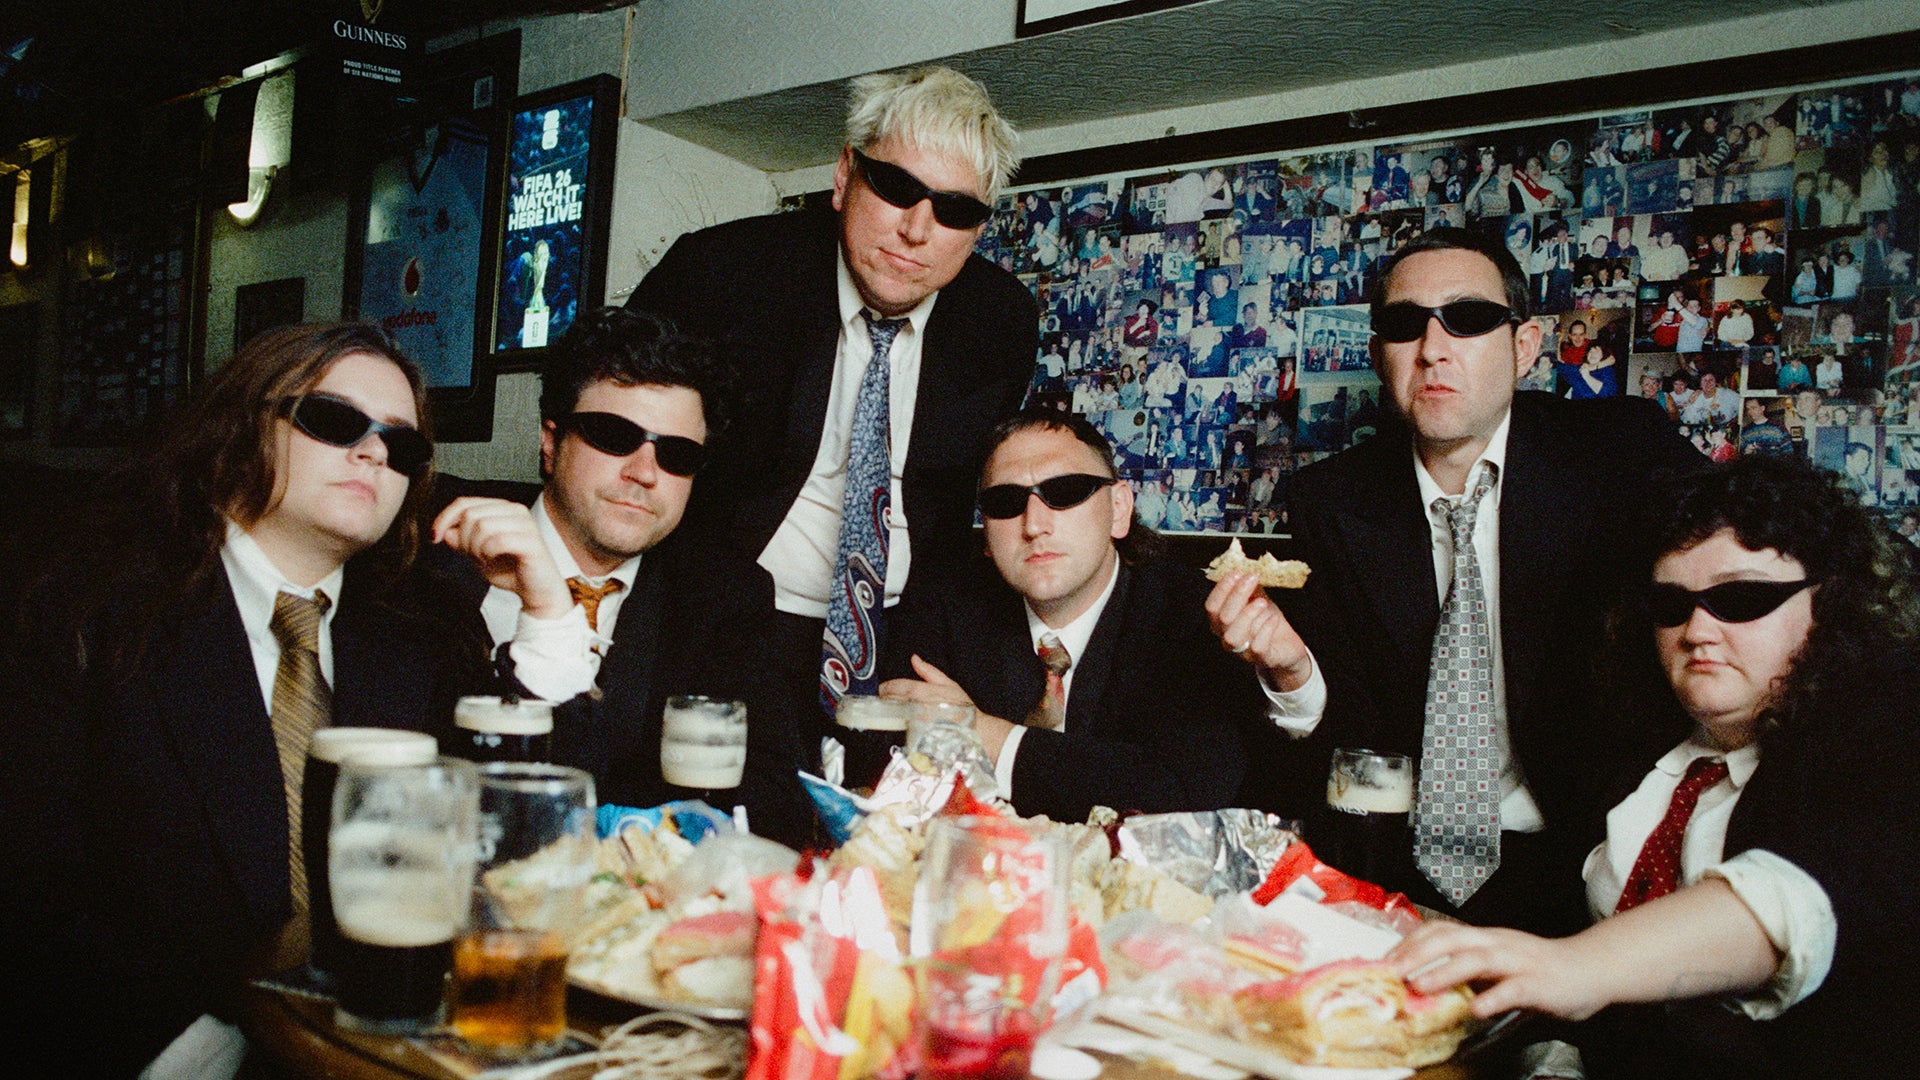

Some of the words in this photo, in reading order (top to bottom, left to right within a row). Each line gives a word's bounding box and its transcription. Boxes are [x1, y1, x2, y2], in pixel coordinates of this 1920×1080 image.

[333, 20, 407, 49] GUINNESS
[523, 173, 553, 195] FIFA
[555, 169, 571, 189] 26
[514, 188, 563, 213] WATCH
[565, 184, 580, 204] IT
[508, 207, 545, 231] HERE
[545, 201, 583, 225] LIVE!
[382, 307, 438, 330] vodafone
